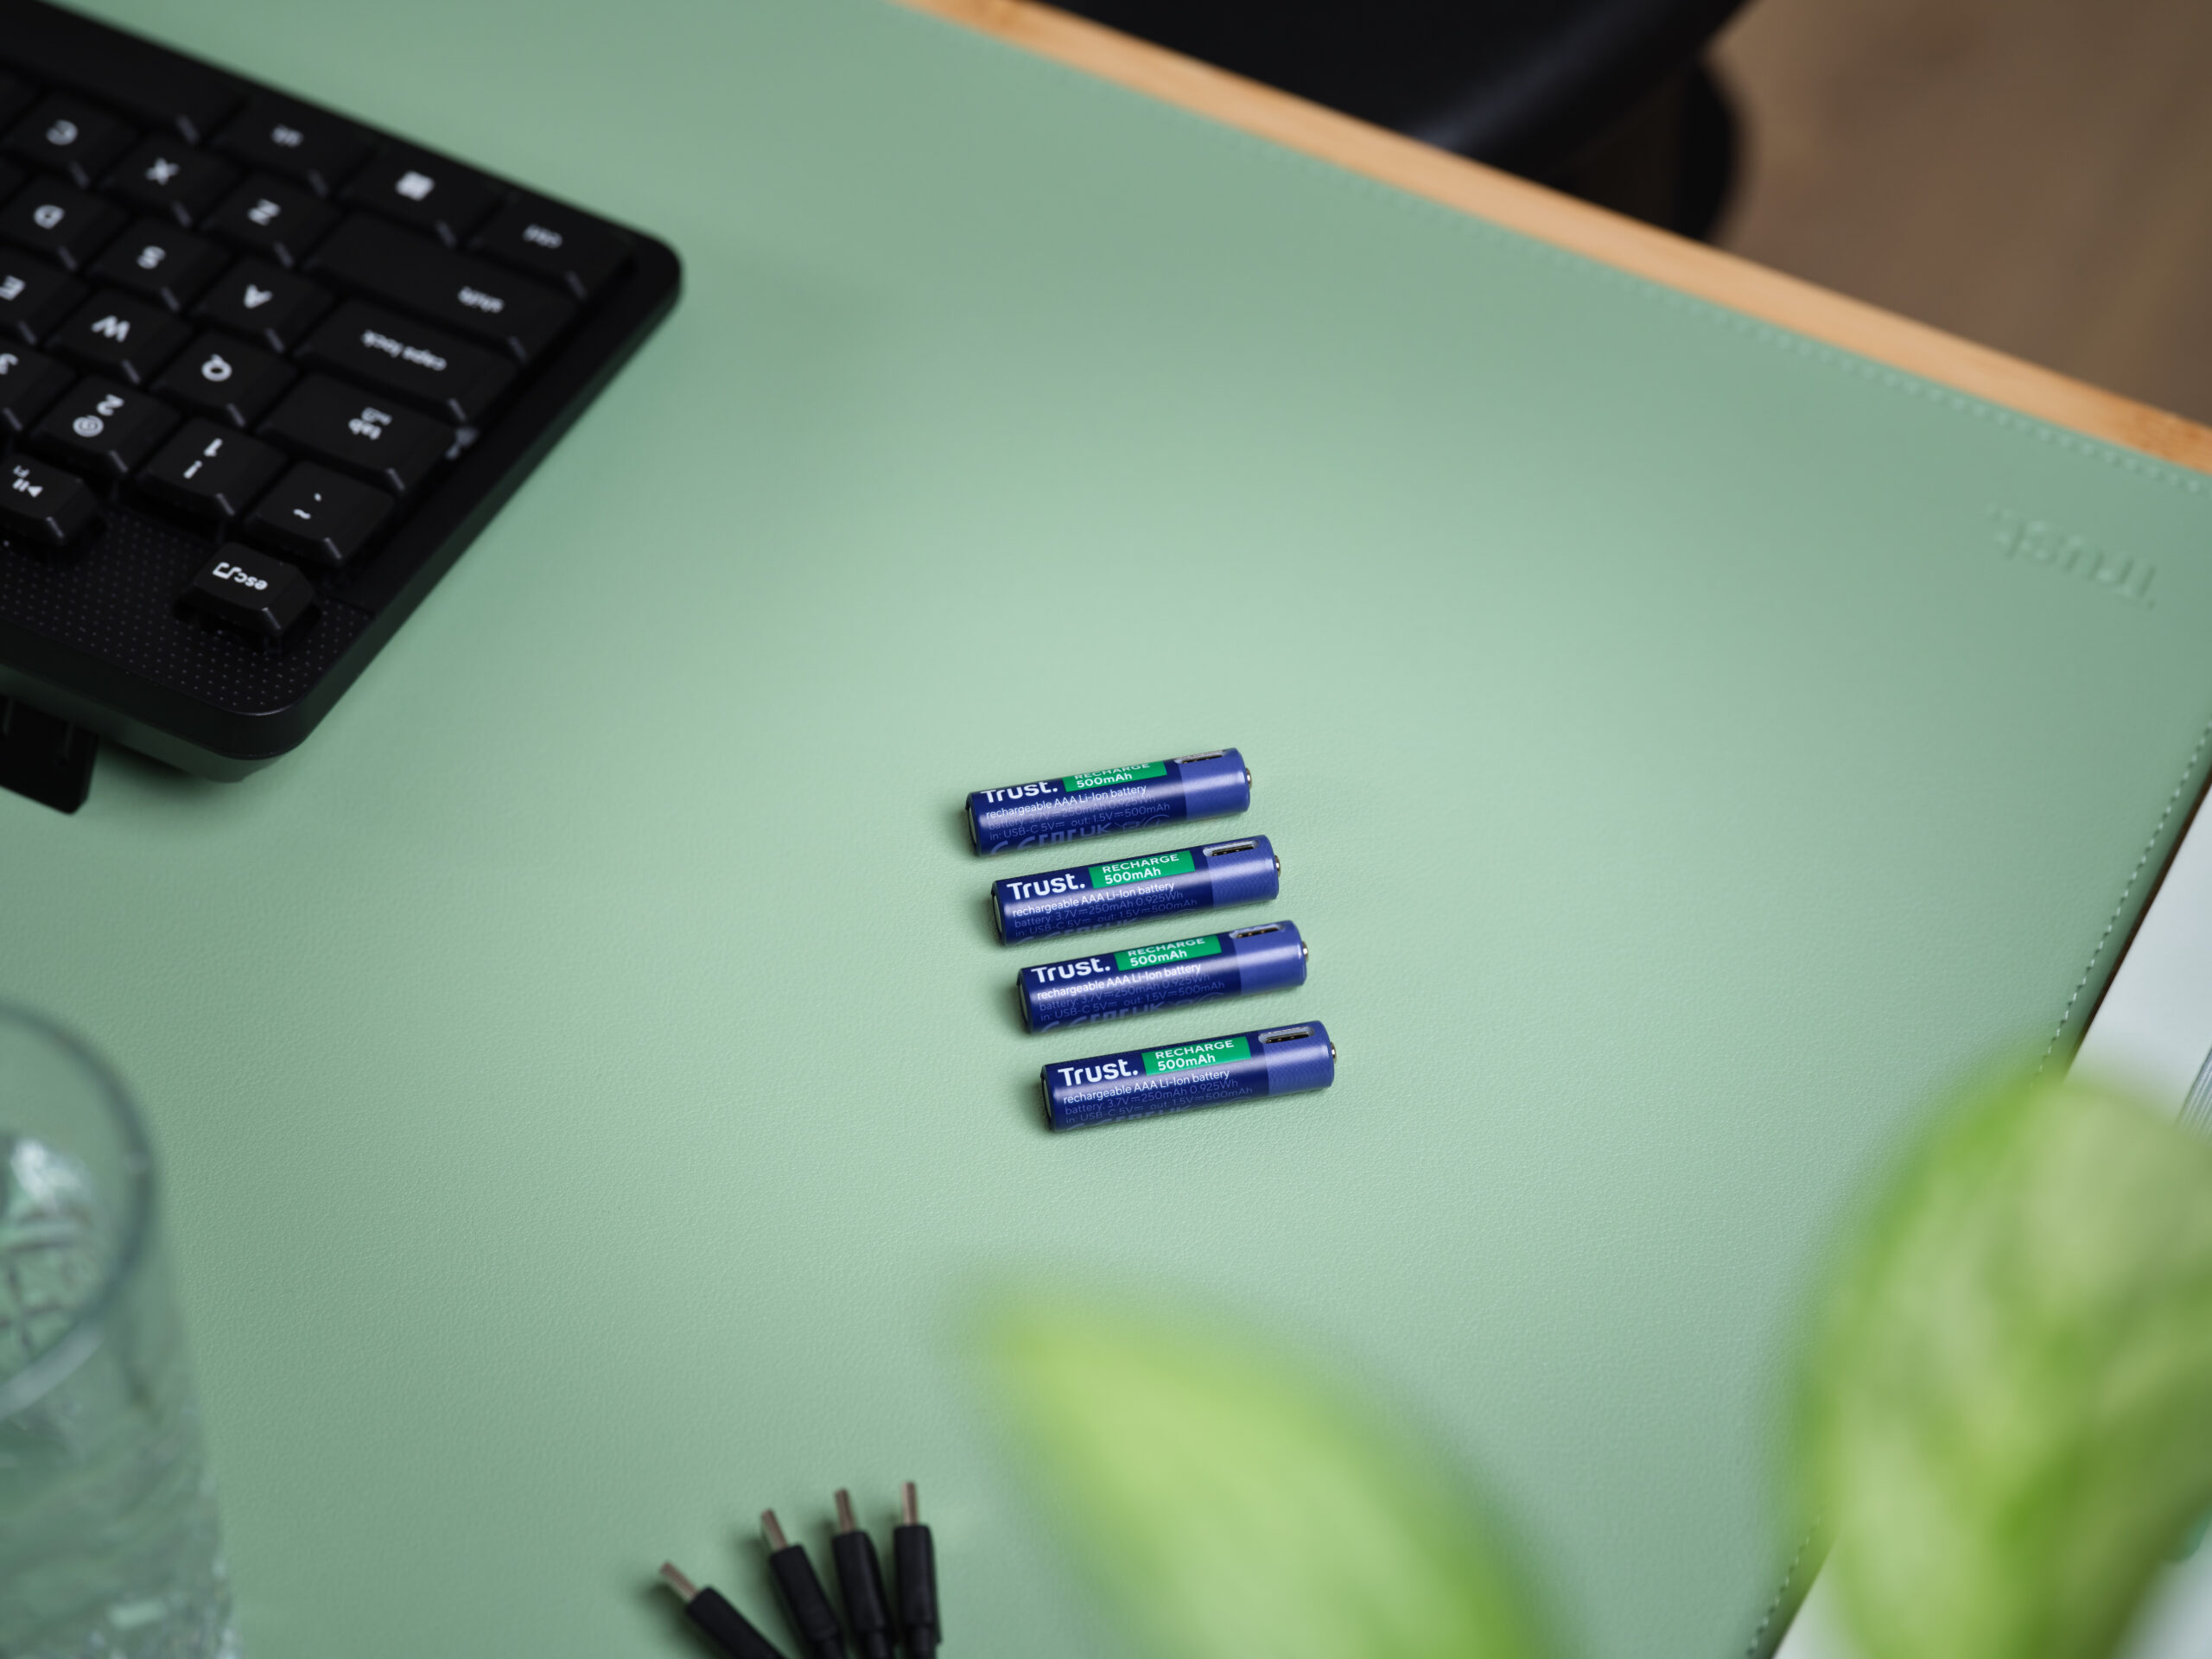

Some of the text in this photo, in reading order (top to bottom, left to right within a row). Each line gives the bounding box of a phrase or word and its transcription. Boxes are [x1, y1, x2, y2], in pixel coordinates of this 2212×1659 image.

[145, 156, 179, 185] X
[33, 204, 64, 230] D
[248, 198, 281, 226] Z
[137, 245, 166, 270] S
[0, 275, 26, 301] E
[243, 283, 273, 309] A
[92, 315, 130, 342] W
[361, 329, 447, 371] caps lock
[201, 353, 232, 382] Q
[96, 394, 124, 416] 2
[73, 415, 104, 437] @
[348, 418, 382, 440] tab
[203, 438, 223, 456] 1
[234, 571, 268, 590] esc
[1075, 763, 1150, 779] RECHARGE
[1077, 772, 1133, 788] 500mAh
[980, 781, 1058, 803] Trust.
[987, 785, 1146, 819] rechargeable AAA Li-Ion battery
[1003, 824, 1038, 838] USB-C
[1103, 854, 1179, 873] RECHARGE
[1006, 873, 1085, 900] Trust.
[1104, 868, 1161, 885] 500mAh
[1013, 883, 1175, 918] rechargeable AAA Li-Ion battery
[1136, 892, 1183, 906] 0.925Wh
[1030, 922, 1065, 934] USB-C
[1128, 938, 1205, 957] RECHARGE
[1130, 950, 1187, 966] 500mAh
[1031, 957, 1111, 983] Trust.
[1037, 964, 1201, 1001] rechargeable AAA Li-Ion battery
[1055, 1006, 1090, 1018] USB-C
[1155, 1040, 1234, 1059] RECHARGE
[1058, 1059, 1139, 1087] Trust.
[1158, 1054, 1216, 1071] 500mAh
[1064, 1070, 1230, 1104] rechargeable AAA Li-Ion battery
[1065, 1103, 1106, 1115] battery:
[1190, 1079, 1238, 1094] 0.925Wh
